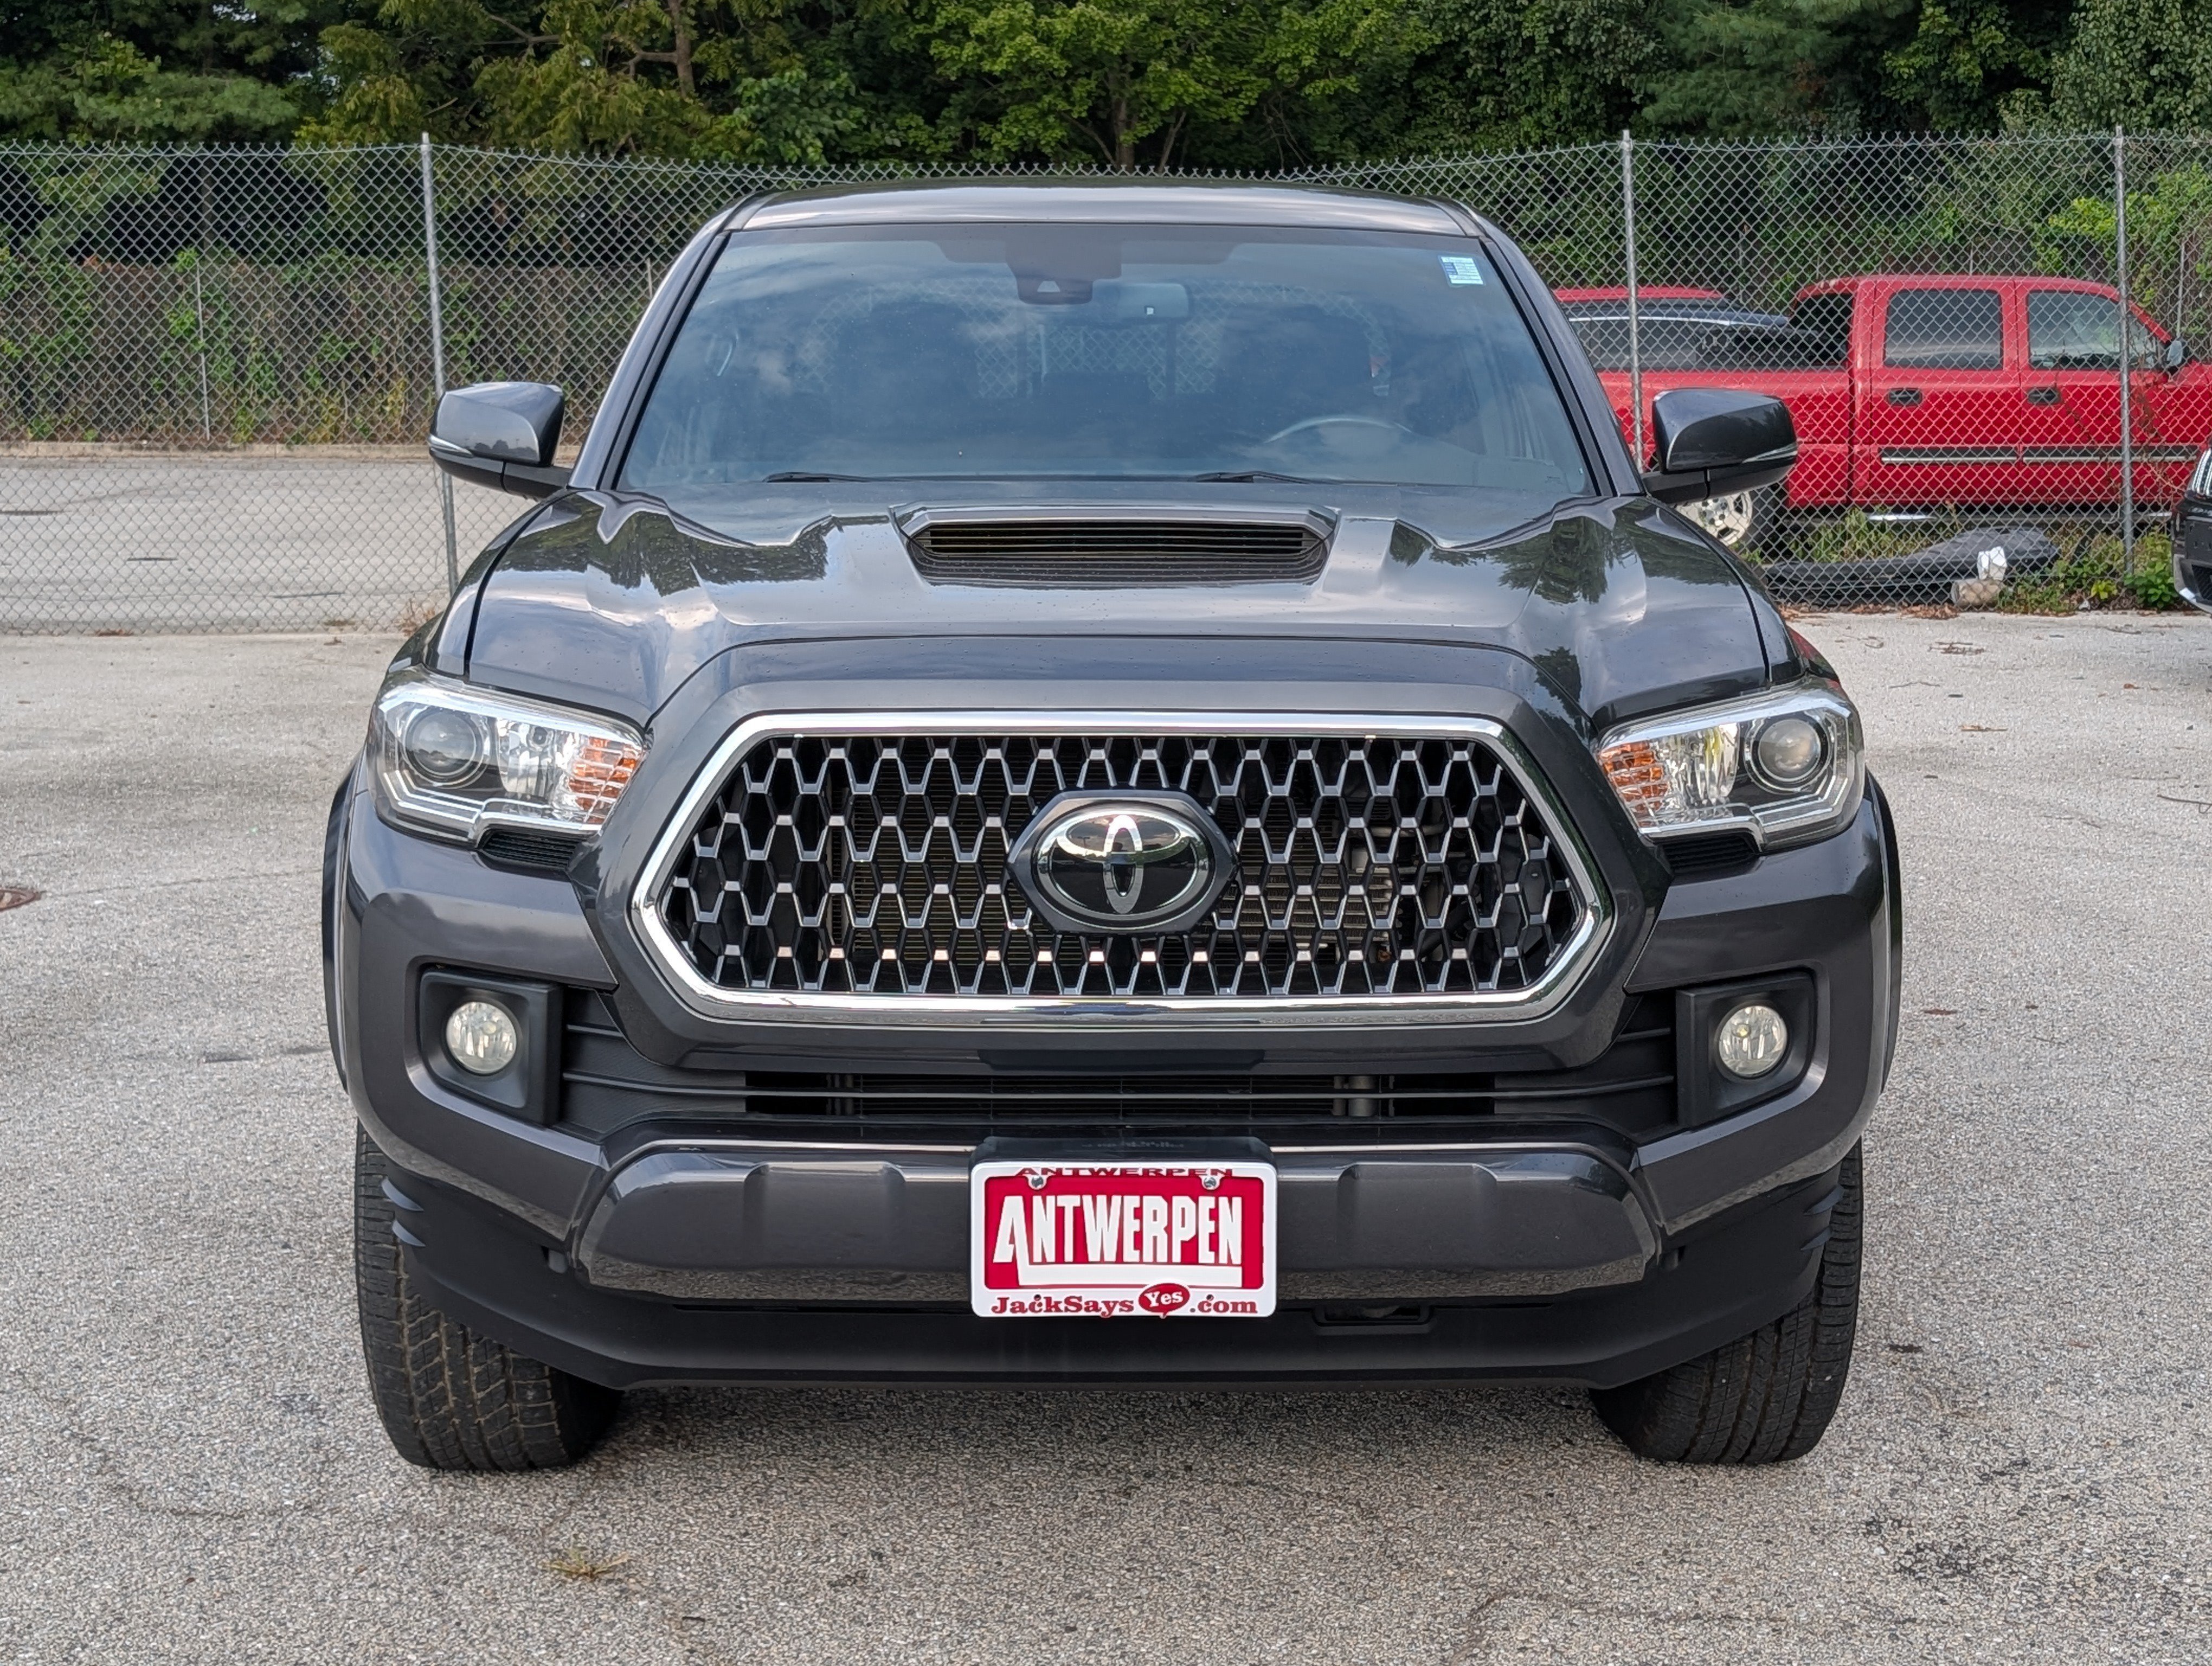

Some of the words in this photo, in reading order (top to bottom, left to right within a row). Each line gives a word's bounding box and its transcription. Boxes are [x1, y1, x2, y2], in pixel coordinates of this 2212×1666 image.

[1015, 1167, 1233, 1176] ANTWERPEN
[993, 1195, 1242, 1265] ANTWERPEN
[991, 1295, 1134, 1317] JackSays
[1144, 1291, 1184, 1308] Yes
